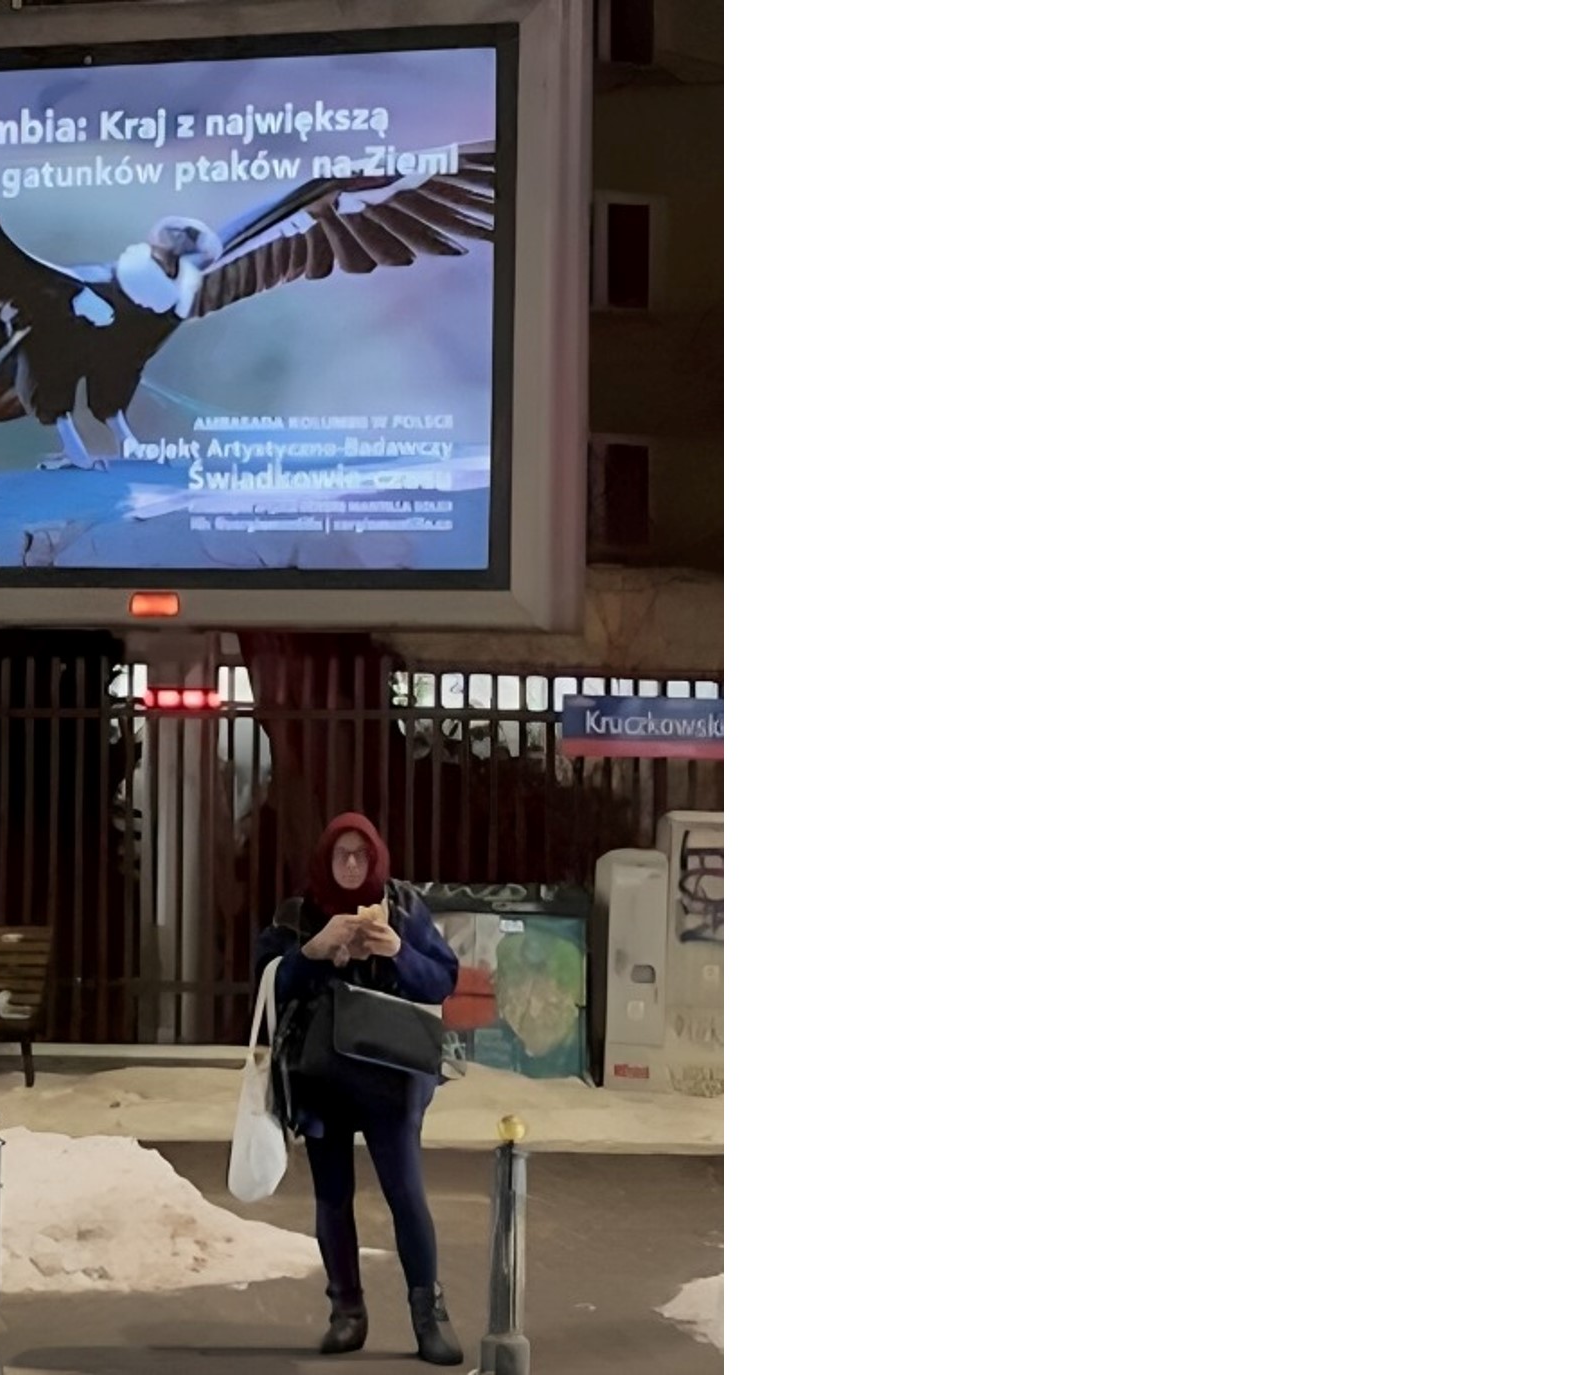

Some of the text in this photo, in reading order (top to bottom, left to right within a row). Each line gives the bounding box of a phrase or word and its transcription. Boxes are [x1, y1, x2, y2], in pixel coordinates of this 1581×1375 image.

[100, 108, 166, 148] Kraj
[177, 114, 195, 138] z
[205, 101, 388, 144] największą
[2, 156, 163, 198] gatunków
[175, 149, 300, 191] ptaków
[313, 155, 352, 178] na
[123, 437, 200, 464] Projekt
